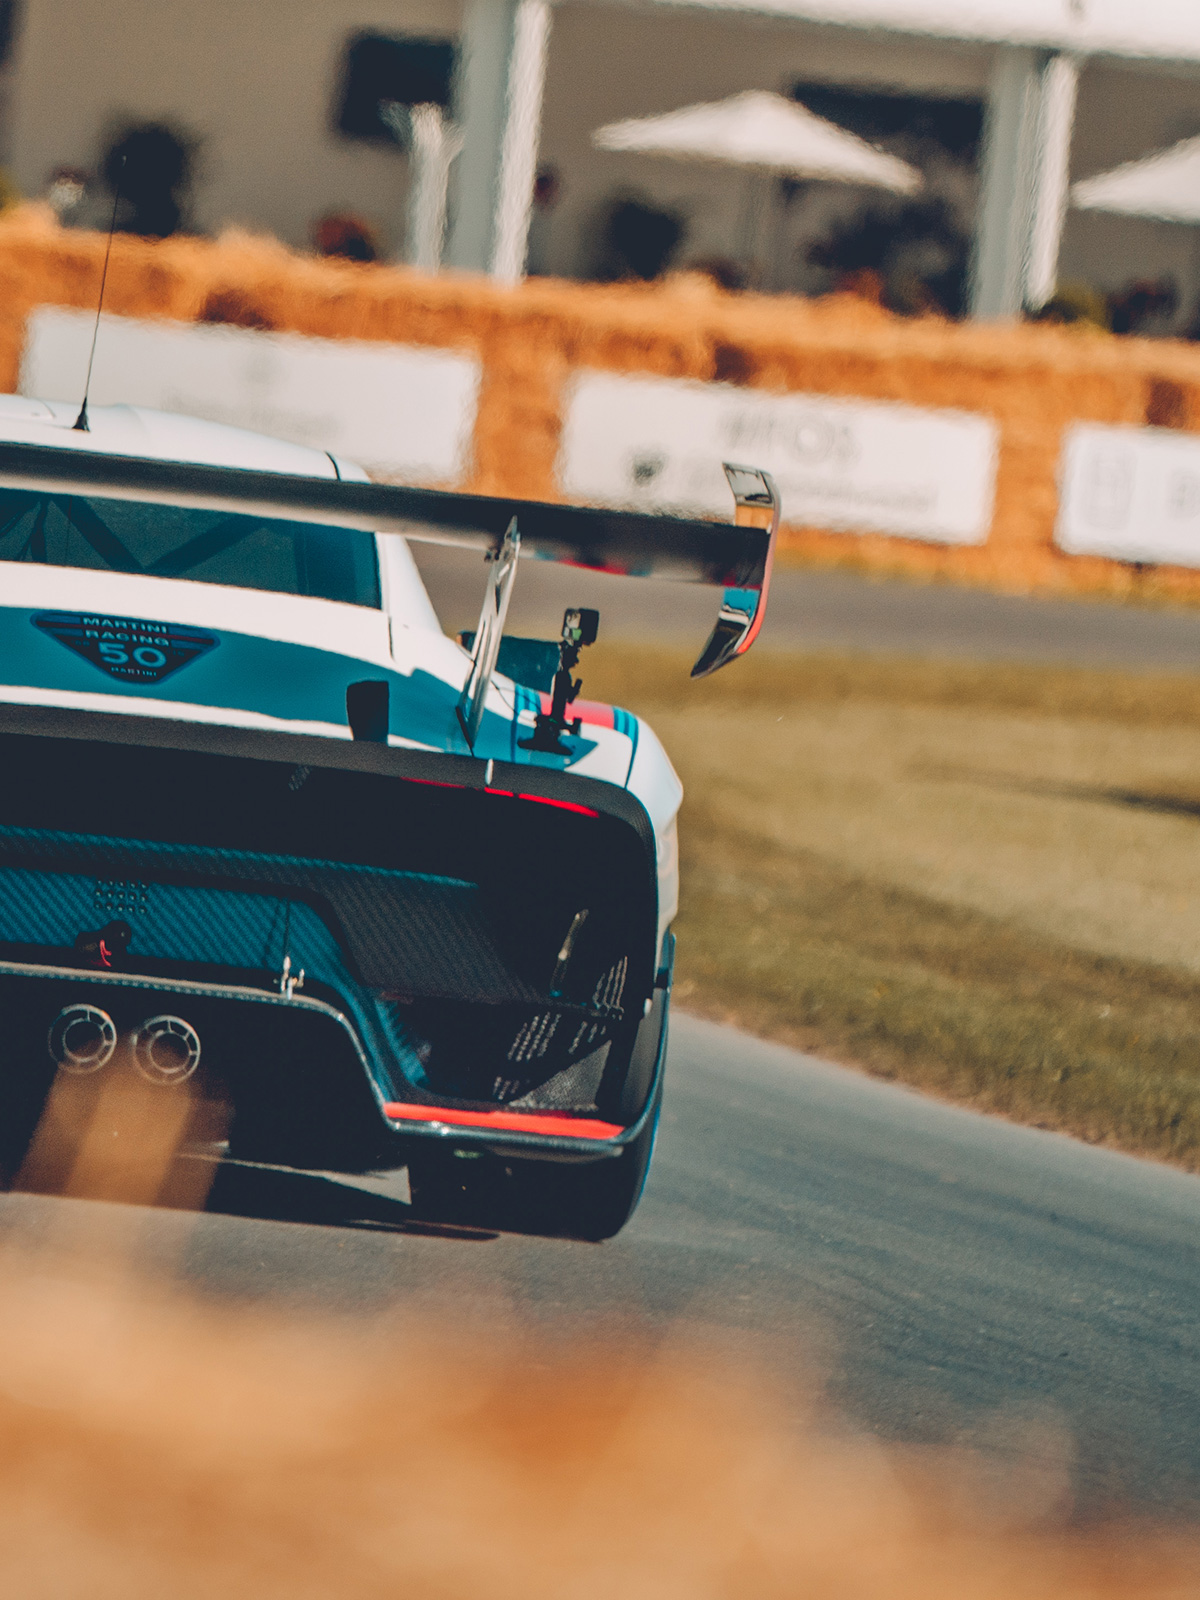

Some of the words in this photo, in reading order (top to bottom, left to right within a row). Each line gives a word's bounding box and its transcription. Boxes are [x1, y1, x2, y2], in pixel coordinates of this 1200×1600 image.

[83, 617, 167, 634] MARTINI
[85, 630, 169, 647] RACING
[98, 642, 167, 668] 50
[111, 667, 157, 677] MARTINI
